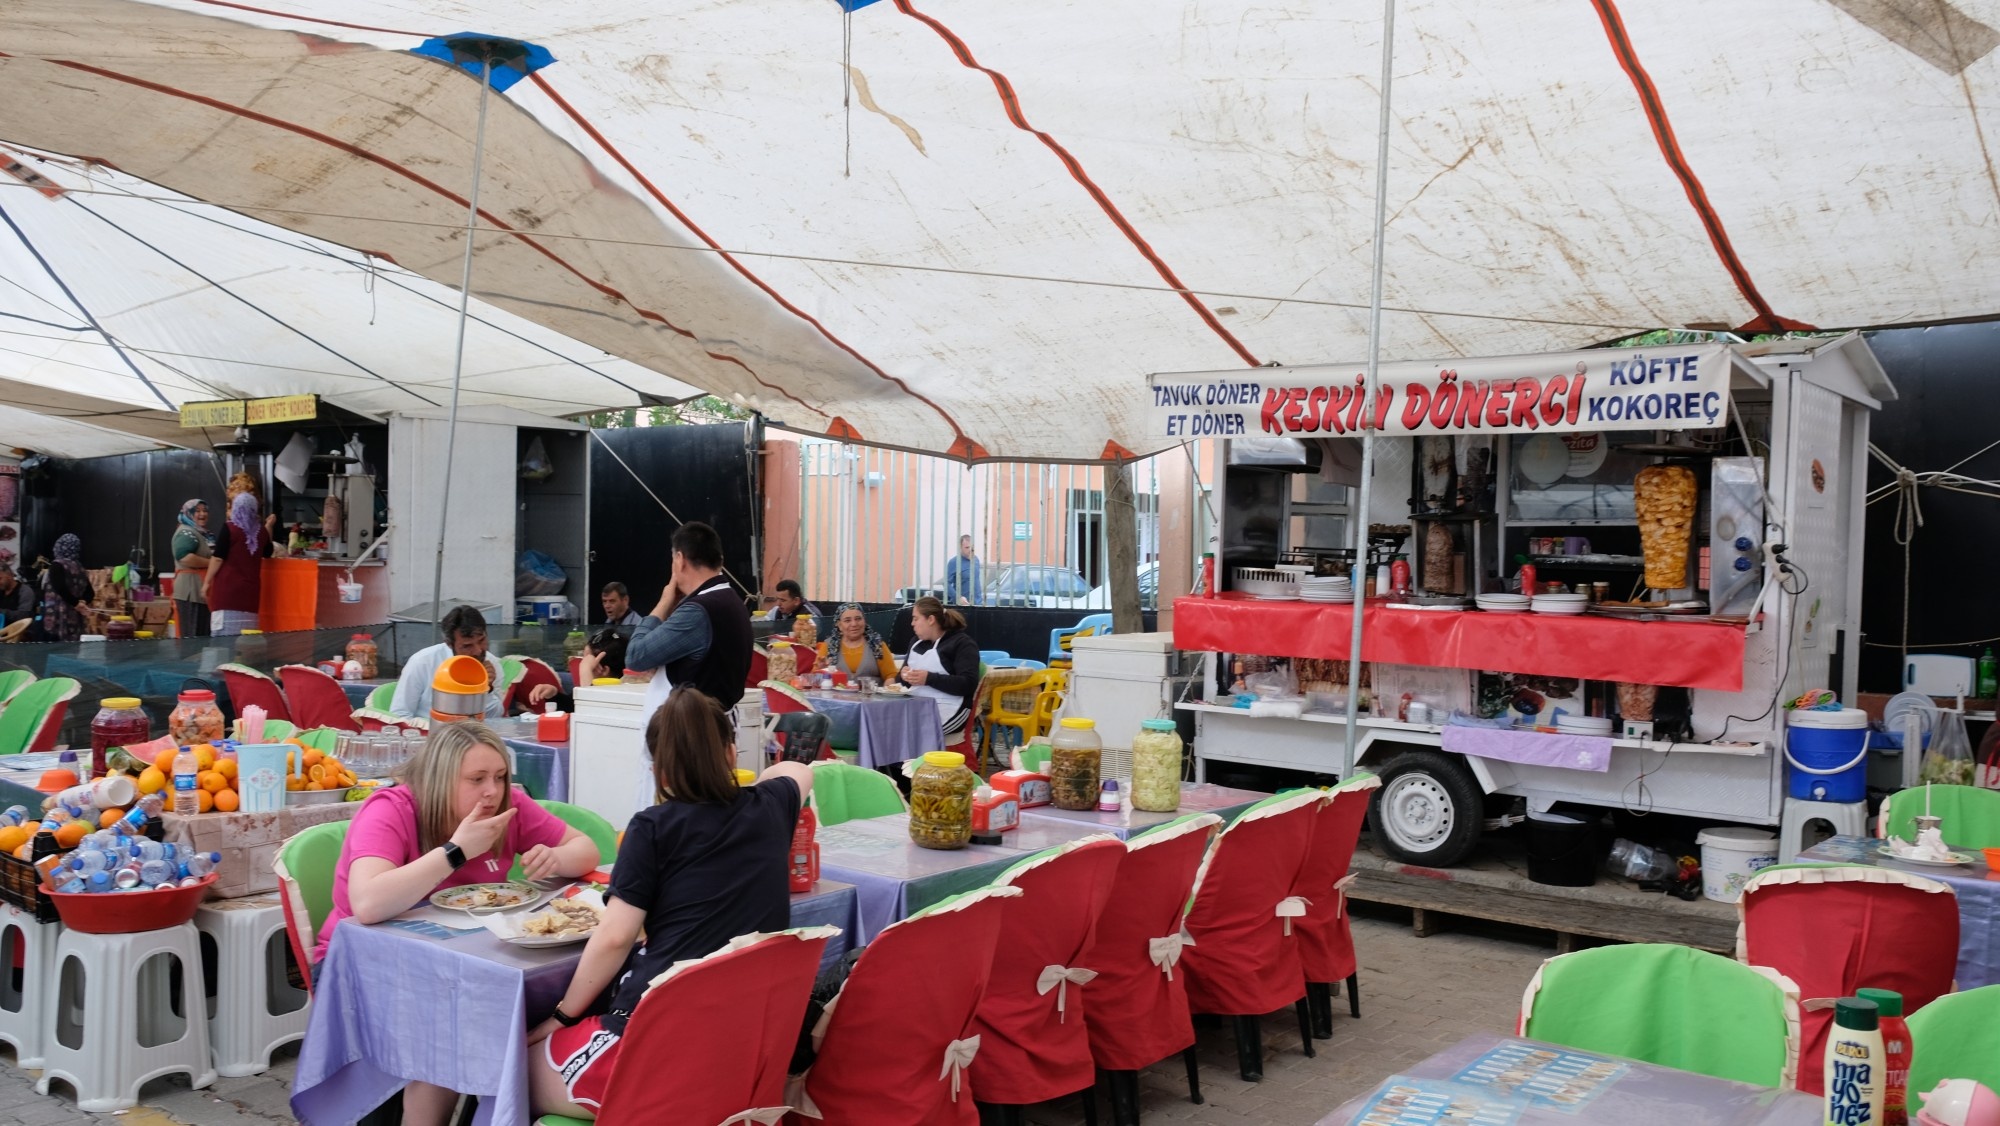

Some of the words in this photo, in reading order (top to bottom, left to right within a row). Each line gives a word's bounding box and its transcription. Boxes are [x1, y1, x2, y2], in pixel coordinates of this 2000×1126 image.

[1610, 354, 1699, 386] KÖFTE
[1153, 385, 1202, 406] TAVUK
[1206, 380, 1260, 405] DÖNER
[1261, 373, 1394, 436] KESKİN
[1401, 361, 1587, 431] DÖNERCİ
[1588, 391, 1720, 425] KOKOREÇ
[1167, 414, 1187, 436] ET
[1192, 409, 1245, 436] DÖNER
